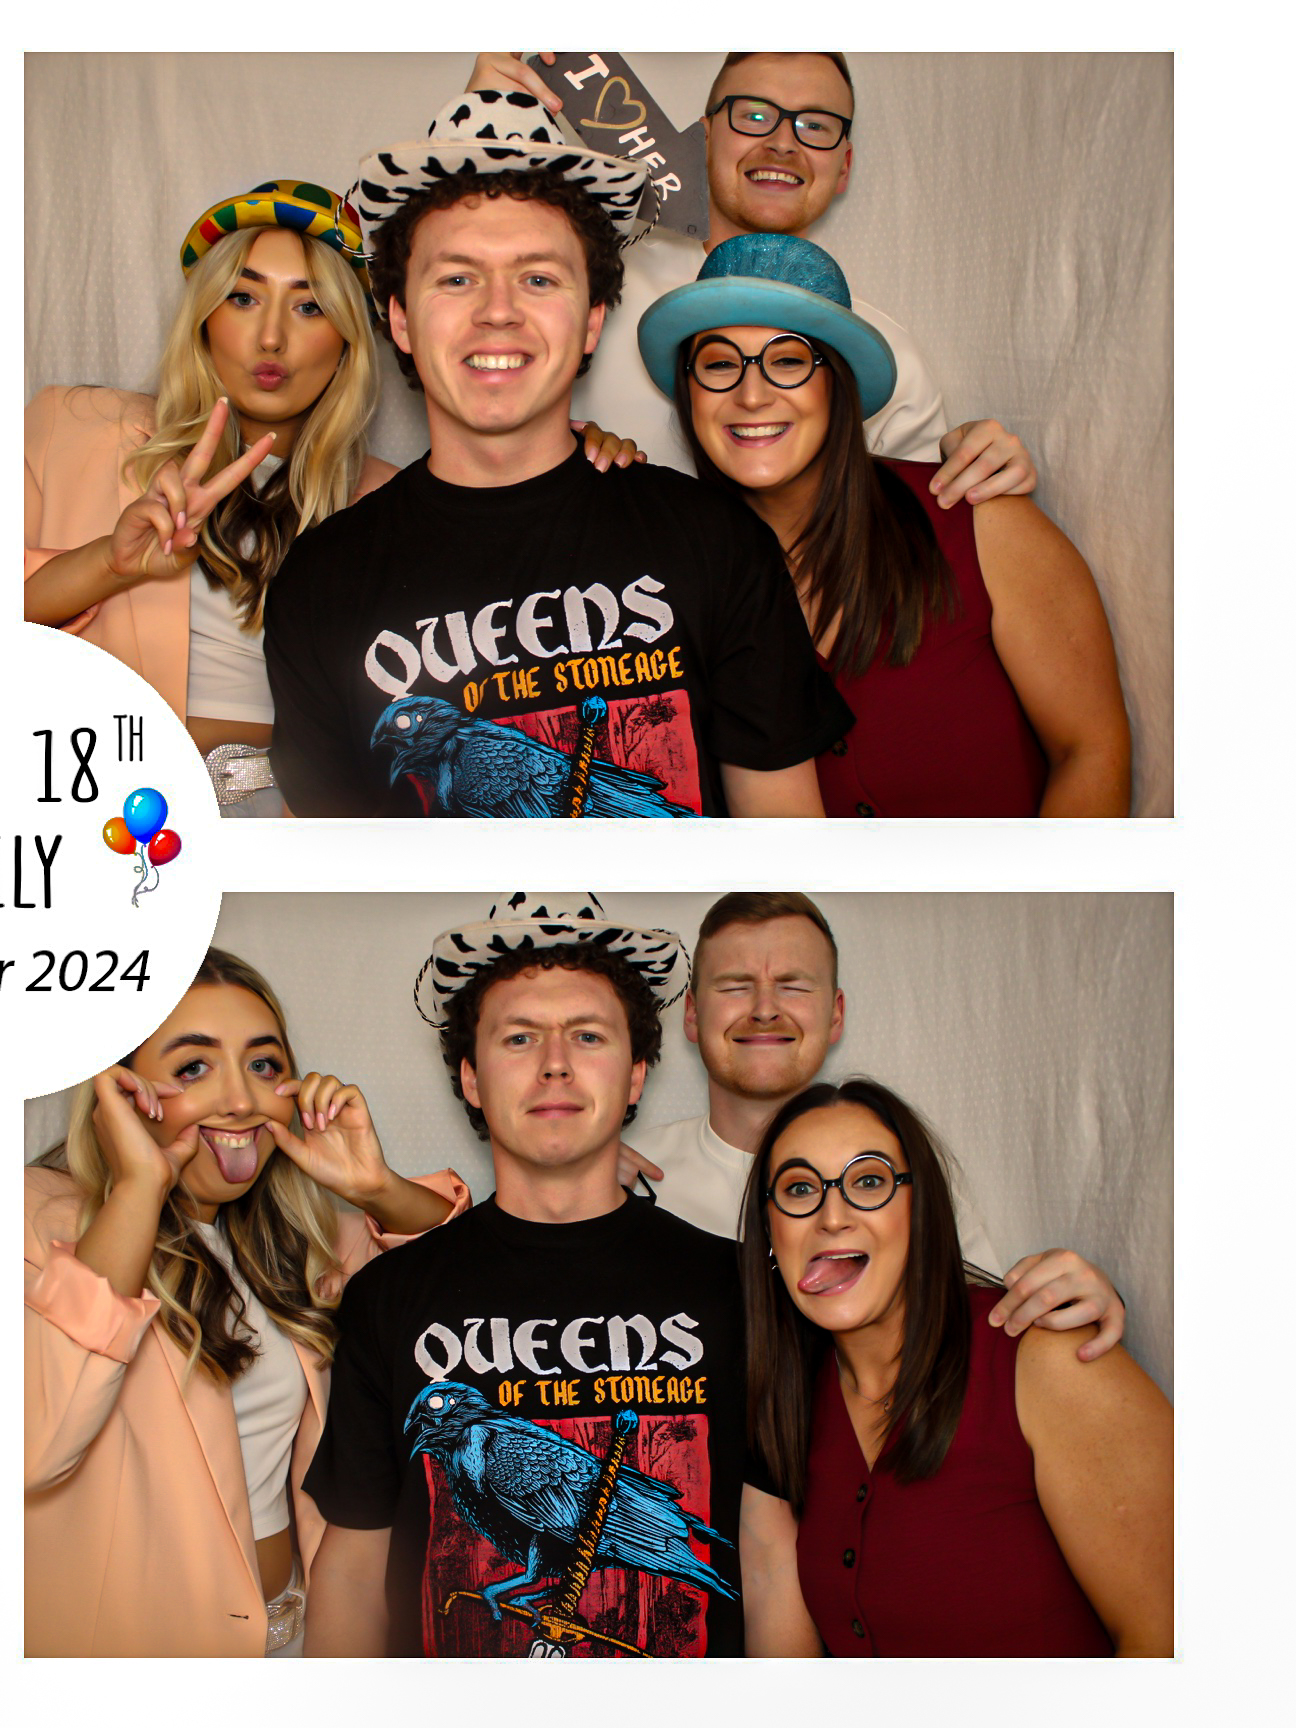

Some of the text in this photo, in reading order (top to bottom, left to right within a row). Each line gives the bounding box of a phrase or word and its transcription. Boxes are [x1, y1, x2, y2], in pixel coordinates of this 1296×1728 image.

[564, 53, 681, 201] I HER
[365, 574, 674, 702] QUEENS
[491, 666, 542, 701] THE
[414, 1312, 704, 1384] QUEENS
[498, 1379, 527, 1407] OF
[534, 1378, 581, 1406] THE
